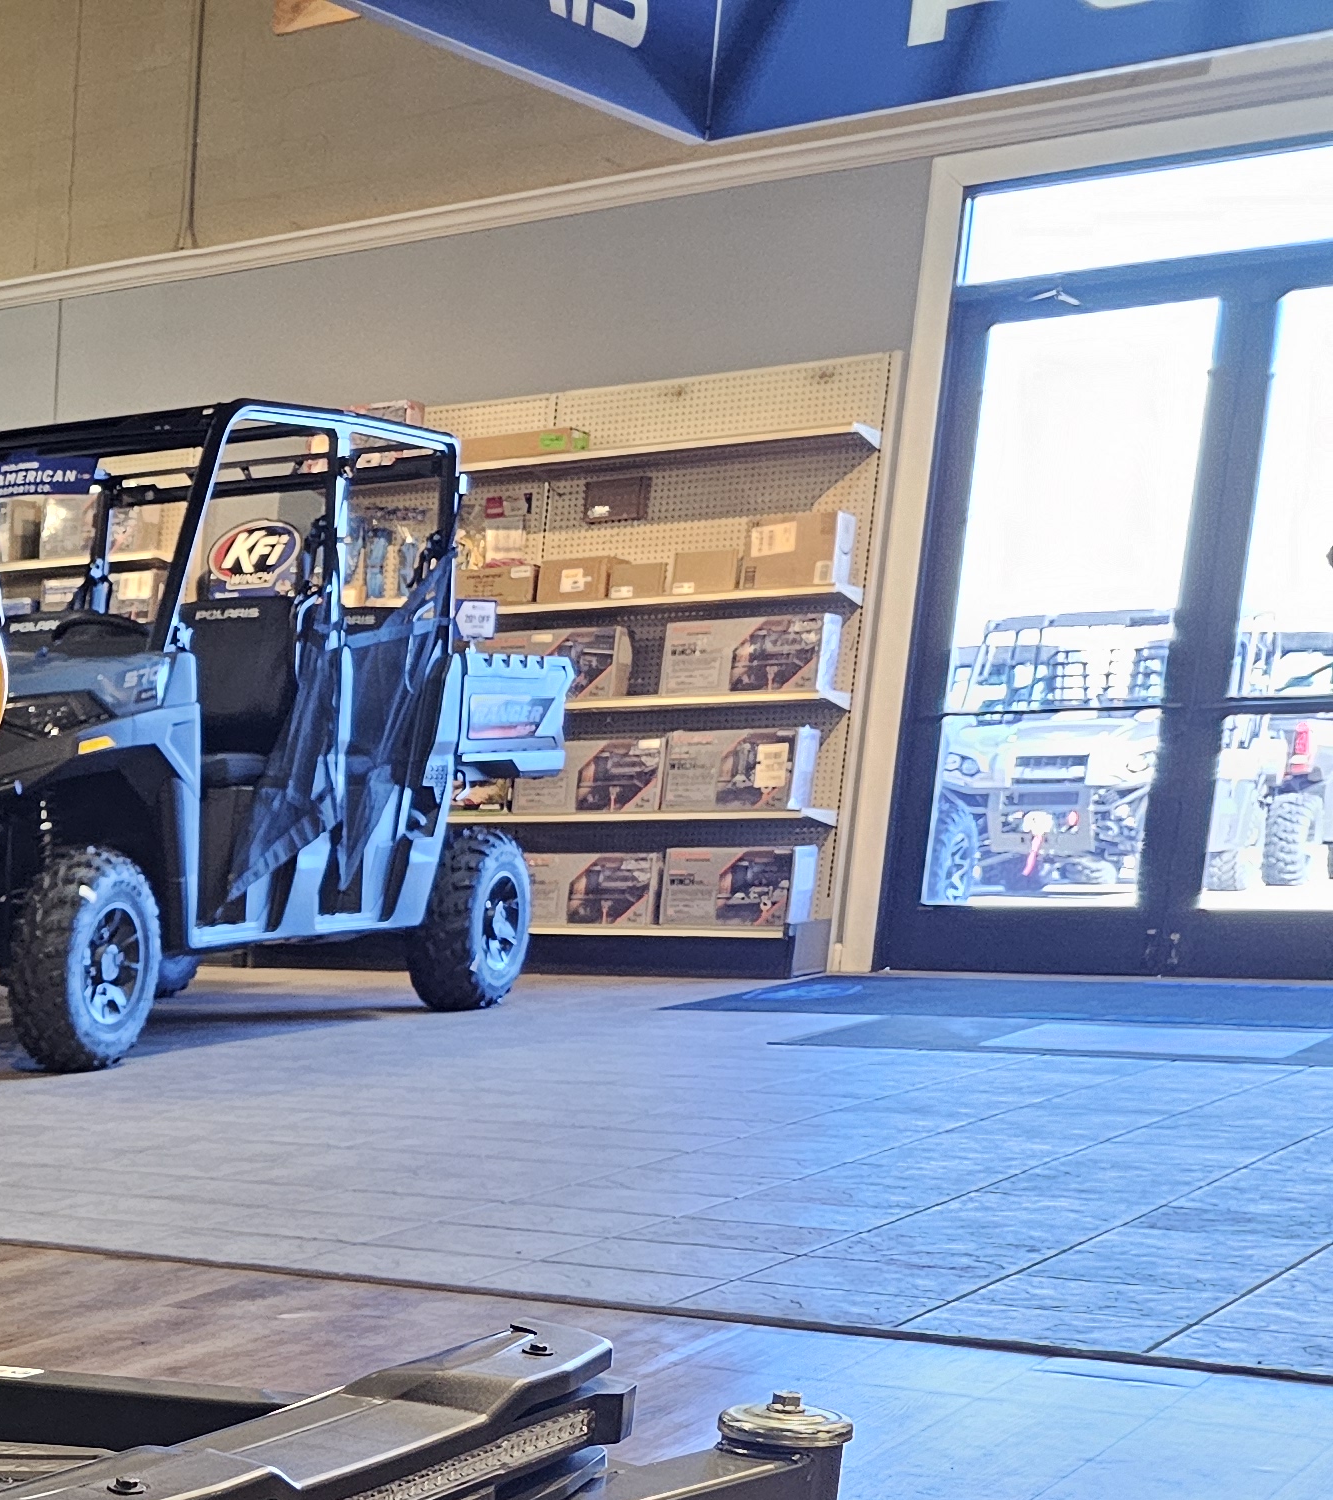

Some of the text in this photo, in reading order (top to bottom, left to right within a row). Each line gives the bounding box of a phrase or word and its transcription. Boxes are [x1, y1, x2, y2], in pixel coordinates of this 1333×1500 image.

[230, 571, 275, 585] WINCH
[195, 607, 260, 621] POLARIS
[9, 619, 63, 633] POLAR
